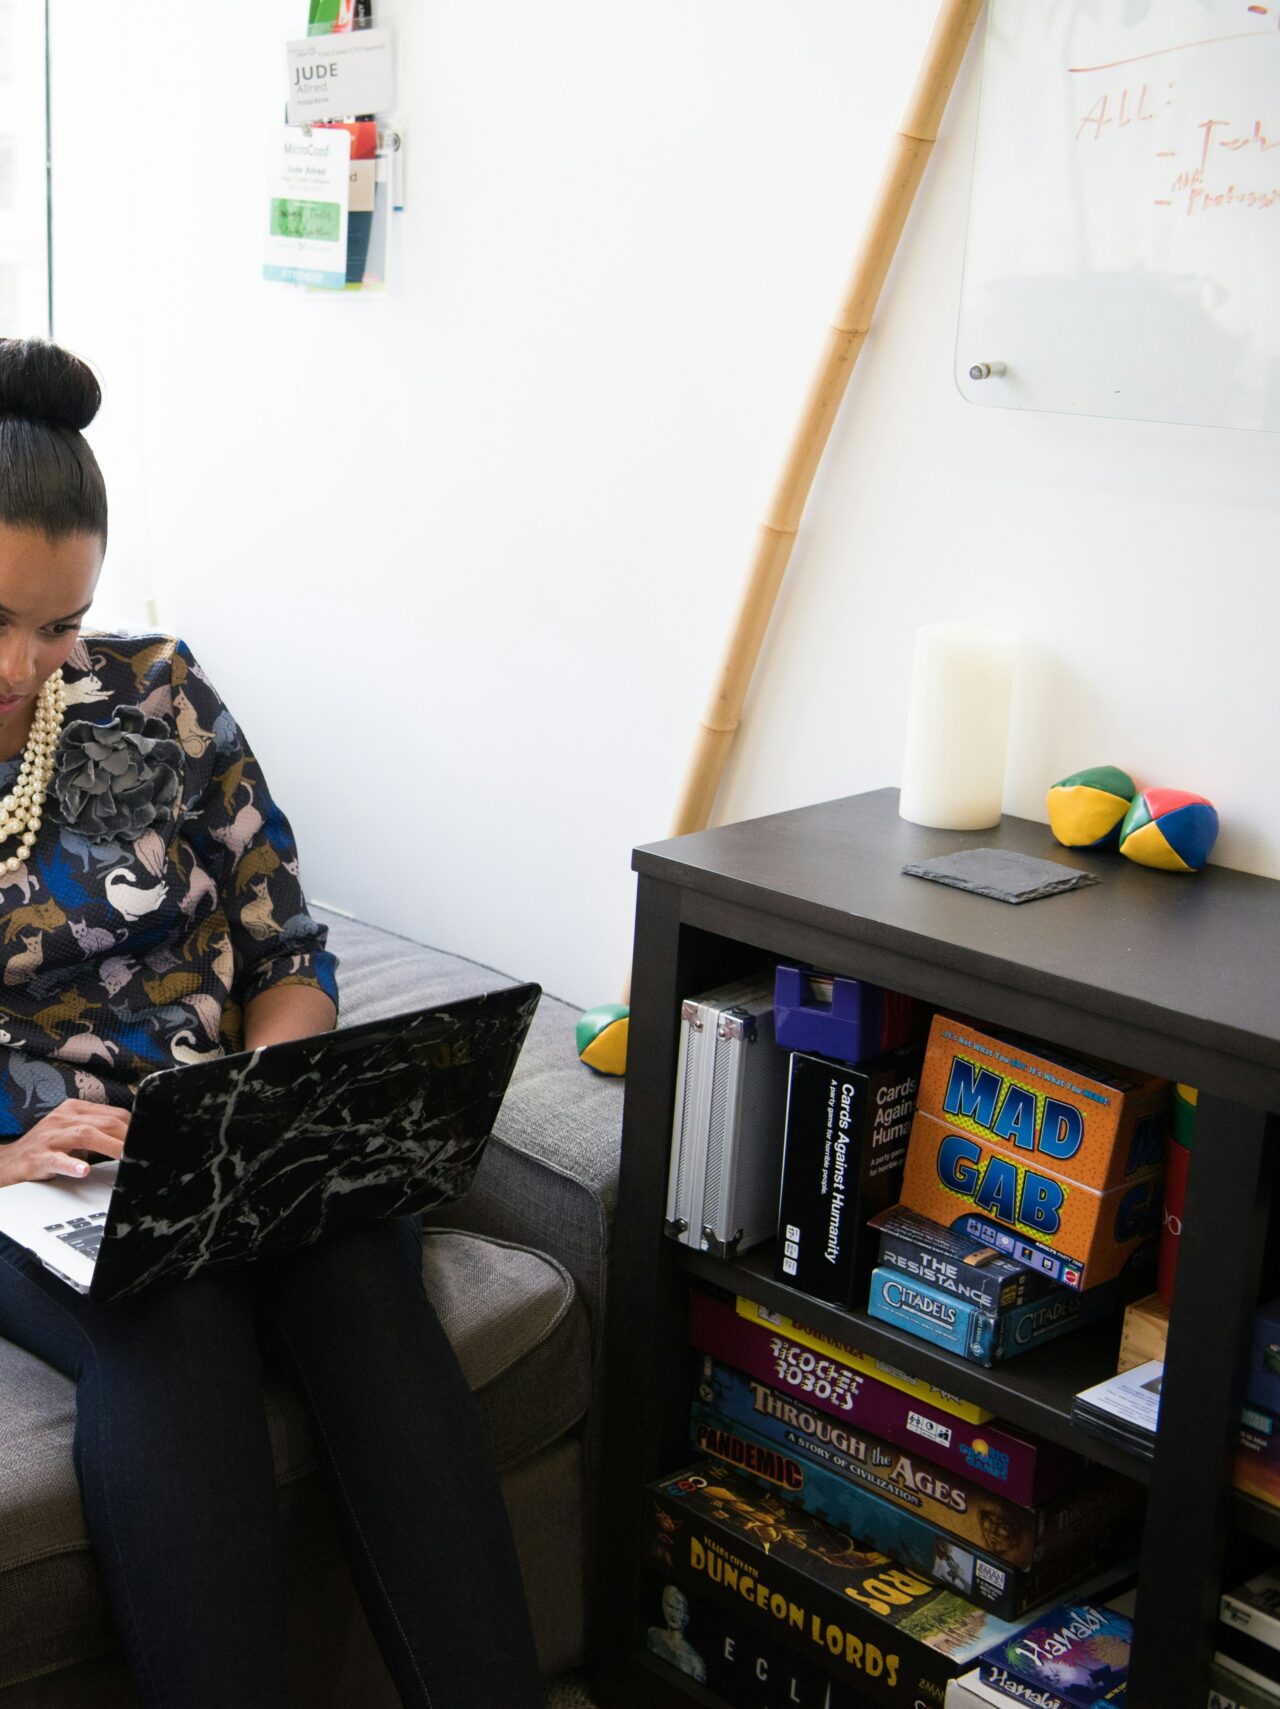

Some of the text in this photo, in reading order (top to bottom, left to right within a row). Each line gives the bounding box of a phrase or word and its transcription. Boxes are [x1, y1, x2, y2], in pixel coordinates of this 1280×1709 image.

[294, 63, 338, 86] JUDE
[297, 82, 328, 94] Allred
[284, 143, 329, 157] MicroConf
[828, 1086, 836, 1107] party
[874, 1099, 914, 1128] Again
[876, 1077, 917, 1106] Cards
[943, 1056, 1084, 1160] MAD
[824, 1083, 855, 1264] Cards Against Humanity
[937, 1135, 1065, 1235] GAB
[883, 1251, 993, 1308] RESISTANCE
[920, 1252, 959, 1279] THE
[883, 1281, 956, 1323] CITADELS
[770, 1337, 864, 1397] RICOCHET
[774, 1359, 854, 1410] ROBOTS
[697, 1423, 805, 1493] PANDEMIC
[749, 1380, 867, 1462] THROUGH
[872, 1447, 891, 1467] the
[891, 1455, 968, 1514] AGES
[787, 1432, 919, 1504] A STORY OF CIVILIZATION
[689, 1536, 901, 1688] DUNGEON LORDS
[844, 1566, 936, 1616] RDS
[1015, 1607, 1110, 1667] Hanabi
[989, 1667, 1062, 1709] Hanabi
